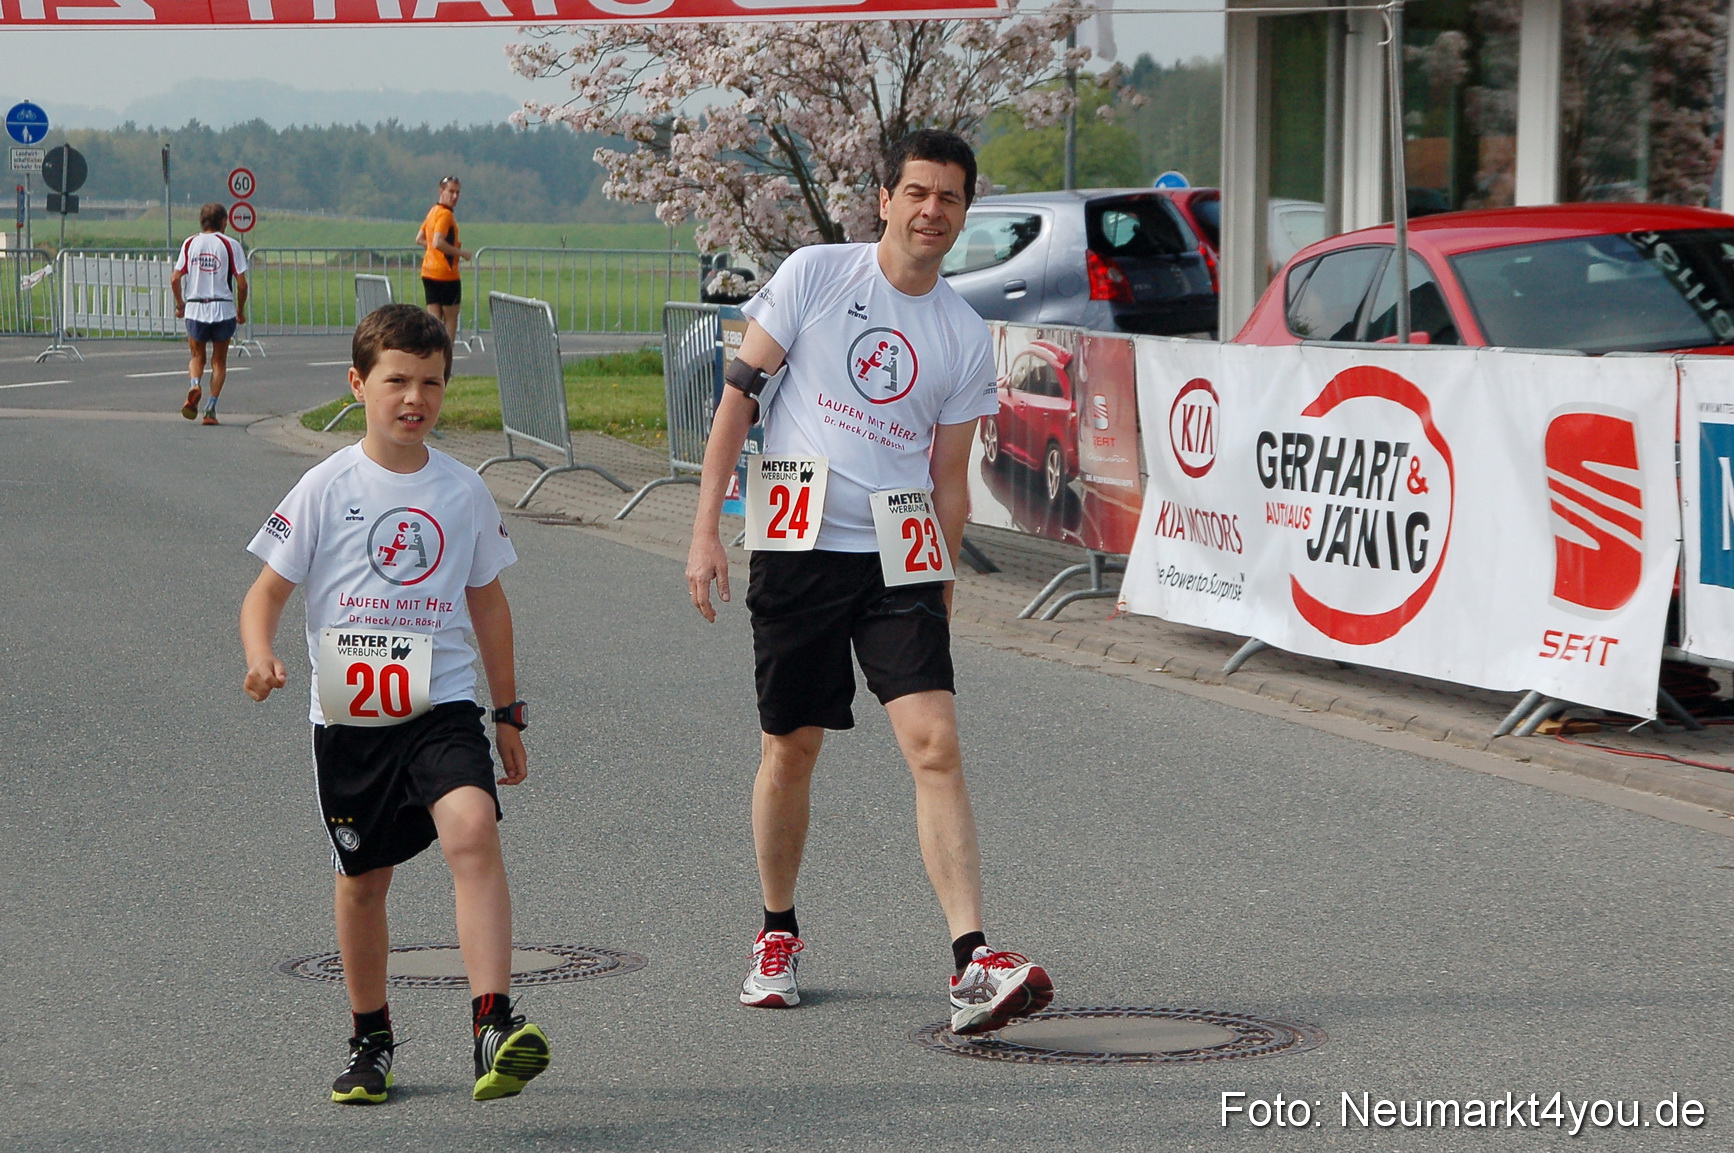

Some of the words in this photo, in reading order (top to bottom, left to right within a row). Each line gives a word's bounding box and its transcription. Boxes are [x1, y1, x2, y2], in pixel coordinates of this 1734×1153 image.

[234, 176, 250, 191] 60
[847, 309, 868, 321] erima
[818, 393, 864, 420] LAUFEN
[888, 421, 917, 441] HERZ
[824, 415, 836, 426] Dr.
[838, 420, 862, 435] Heck
[868, 432, 879, 443] Dr.
[1181, 403, 1213, 455] KIA
[761, 460, 797, 472] MEYER
[761, 472, 798, 481] WERBUNG
[1256, 430, 1411, 502] GERHART
[1406, 455, 1430, 495] &
[767, 484, 810, 540] 24
[1154, 500, 1186, 541] KIA
[1184, 505, 1243, 555] MOTORS
[1306, 503, 1431, 574] JÄNIG
[901, 517, 943, 573] 23
[1196, 573, 1208, 592] to
[339, 592, 390, 610] LAUFEN
[396, 599, 421, 610] MIT
[425, 597, 453, 613] HRZ
[349, 614, 363, 623] Dr.
[365, 616, 390, 625] Heck
[400, 617, 414, 626] Dr.
[337, 634, 387, 648] MEYER
[337, 647, 388, 657] WERBUNG
[346, 662, 413, 718] 20
